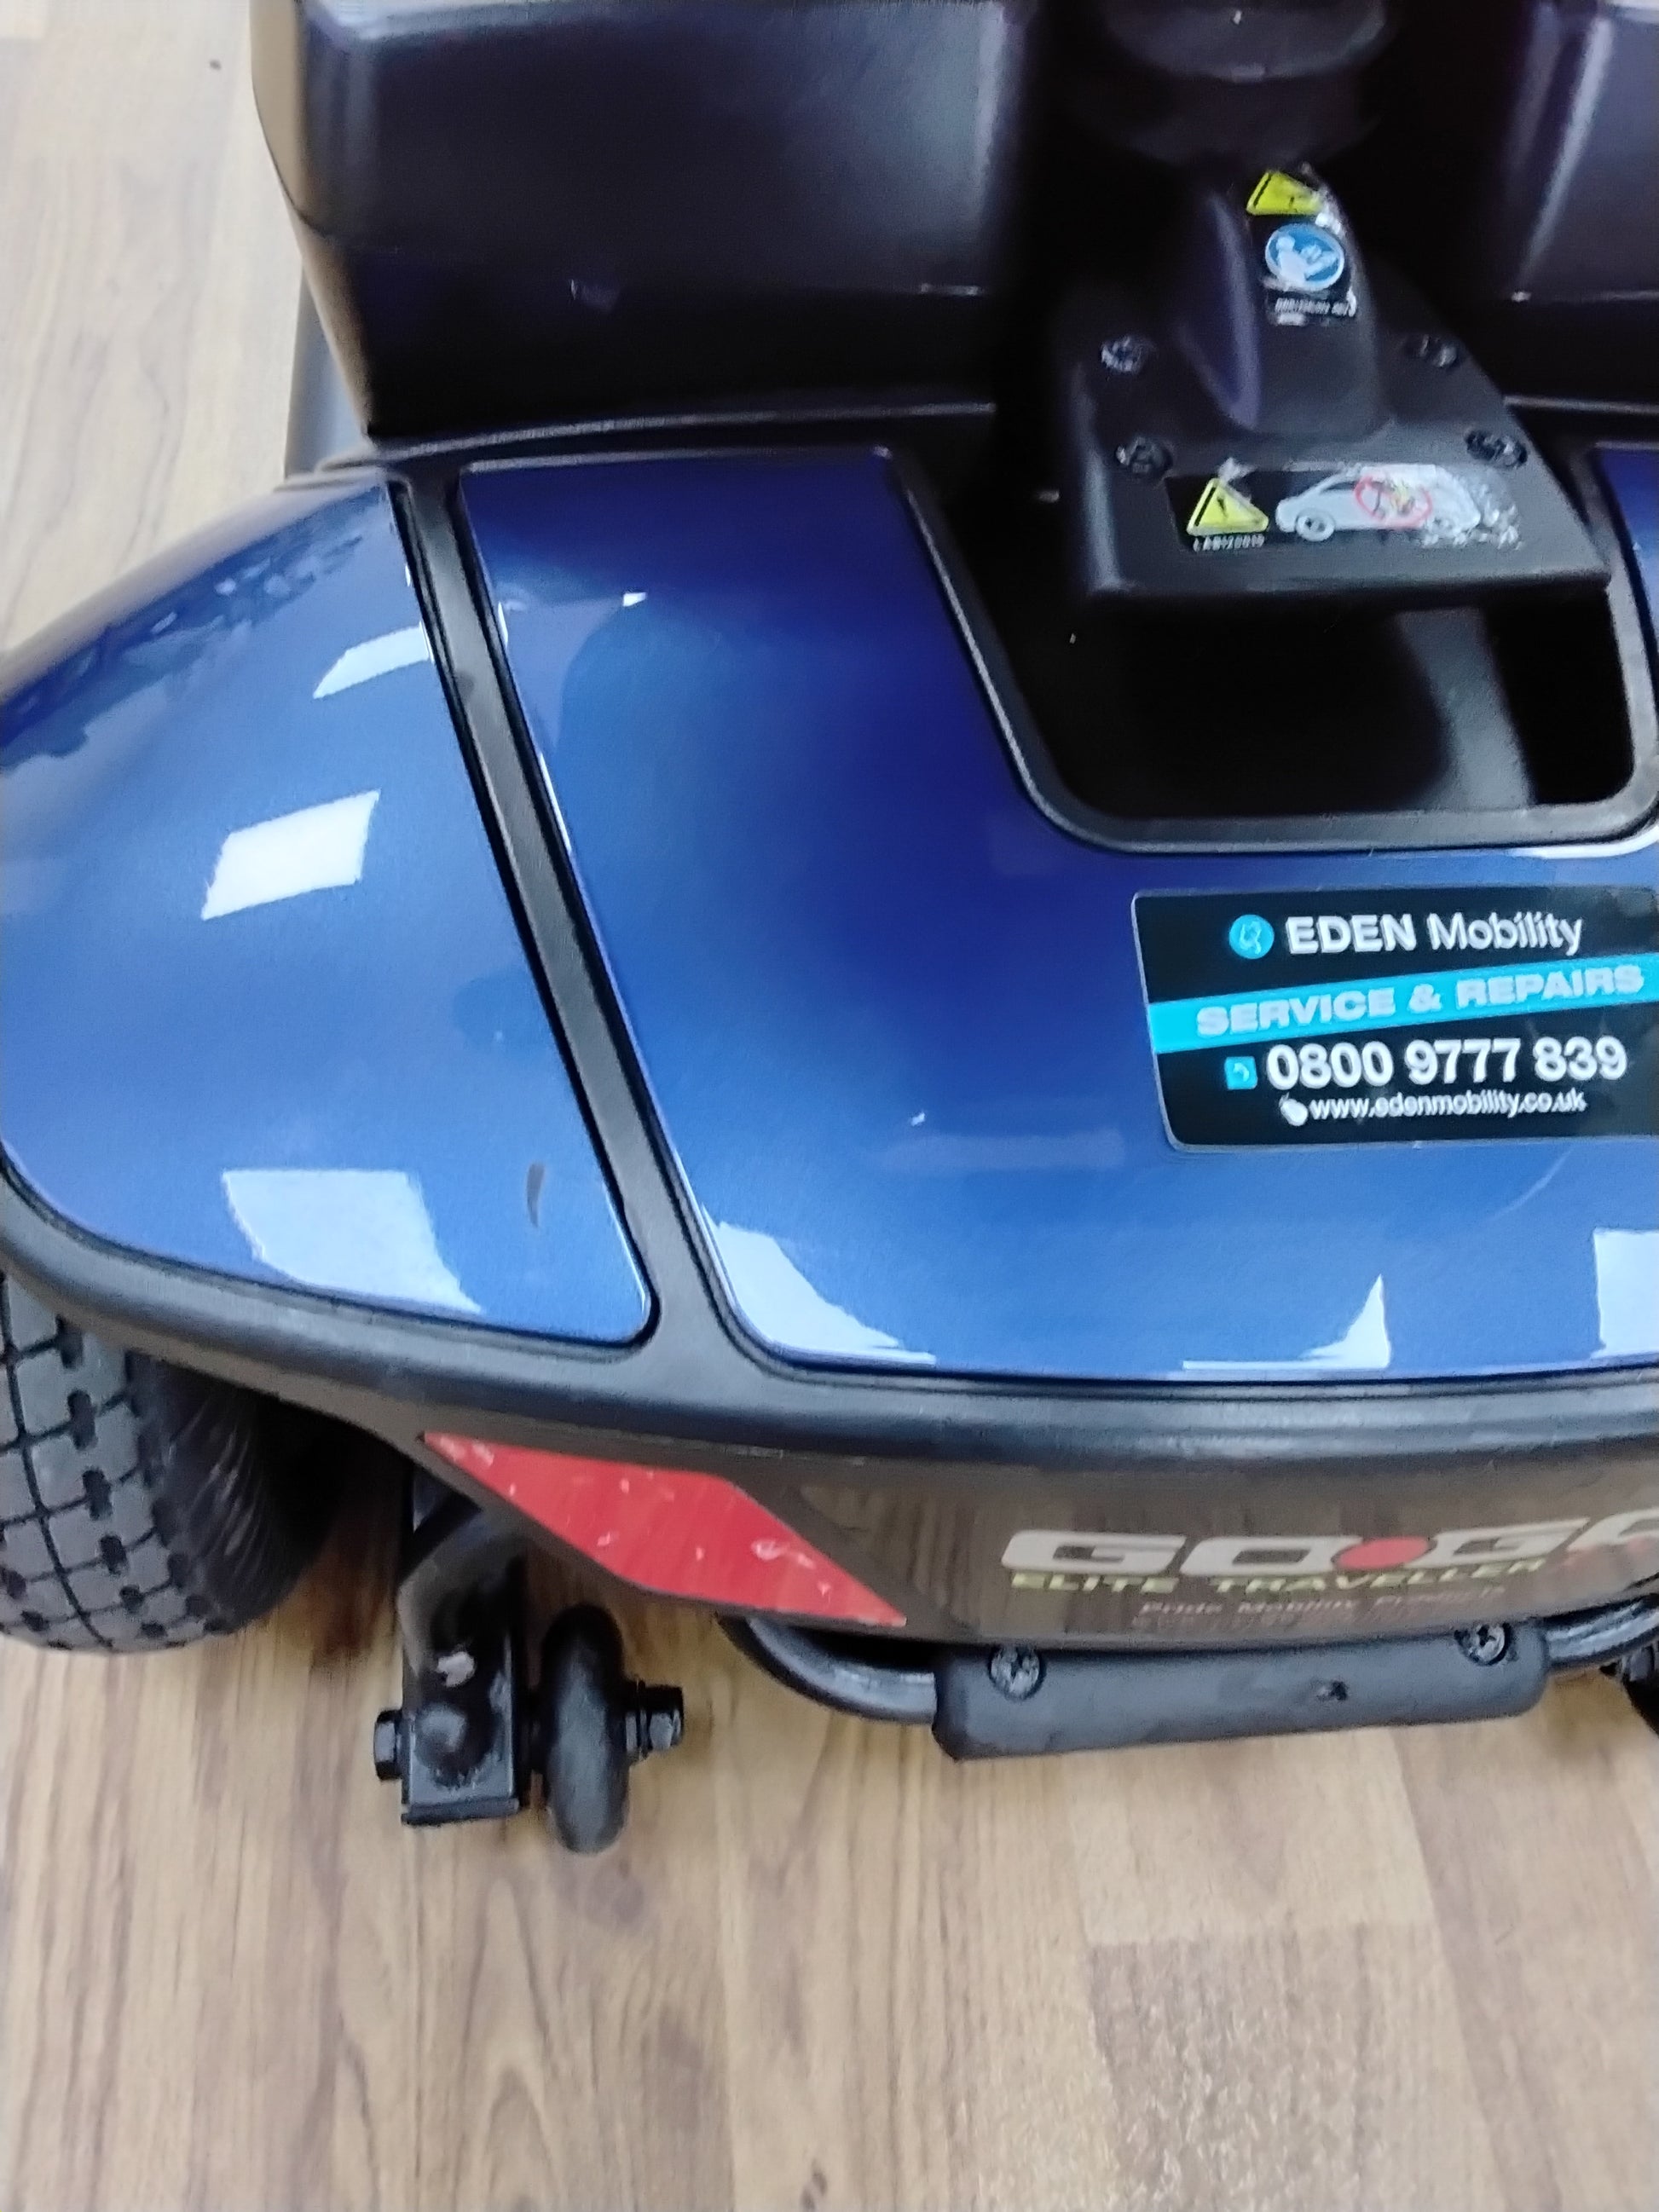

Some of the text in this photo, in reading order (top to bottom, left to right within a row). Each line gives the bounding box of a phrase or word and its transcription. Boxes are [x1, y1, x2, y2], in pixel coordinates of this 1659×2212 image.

[1286, 911, 1583, 956] EDEN Mobility
[1197, 964, 1645, 1036] SERVICE & REPAIRS
[1267, 1035, 1629, 1089] 0800 9777 839
[1309, 1088, 1587, 1118] www.edenmobility.co.uk
[1011, 1559, 1546, 1593] ELITE TRAVELLER
